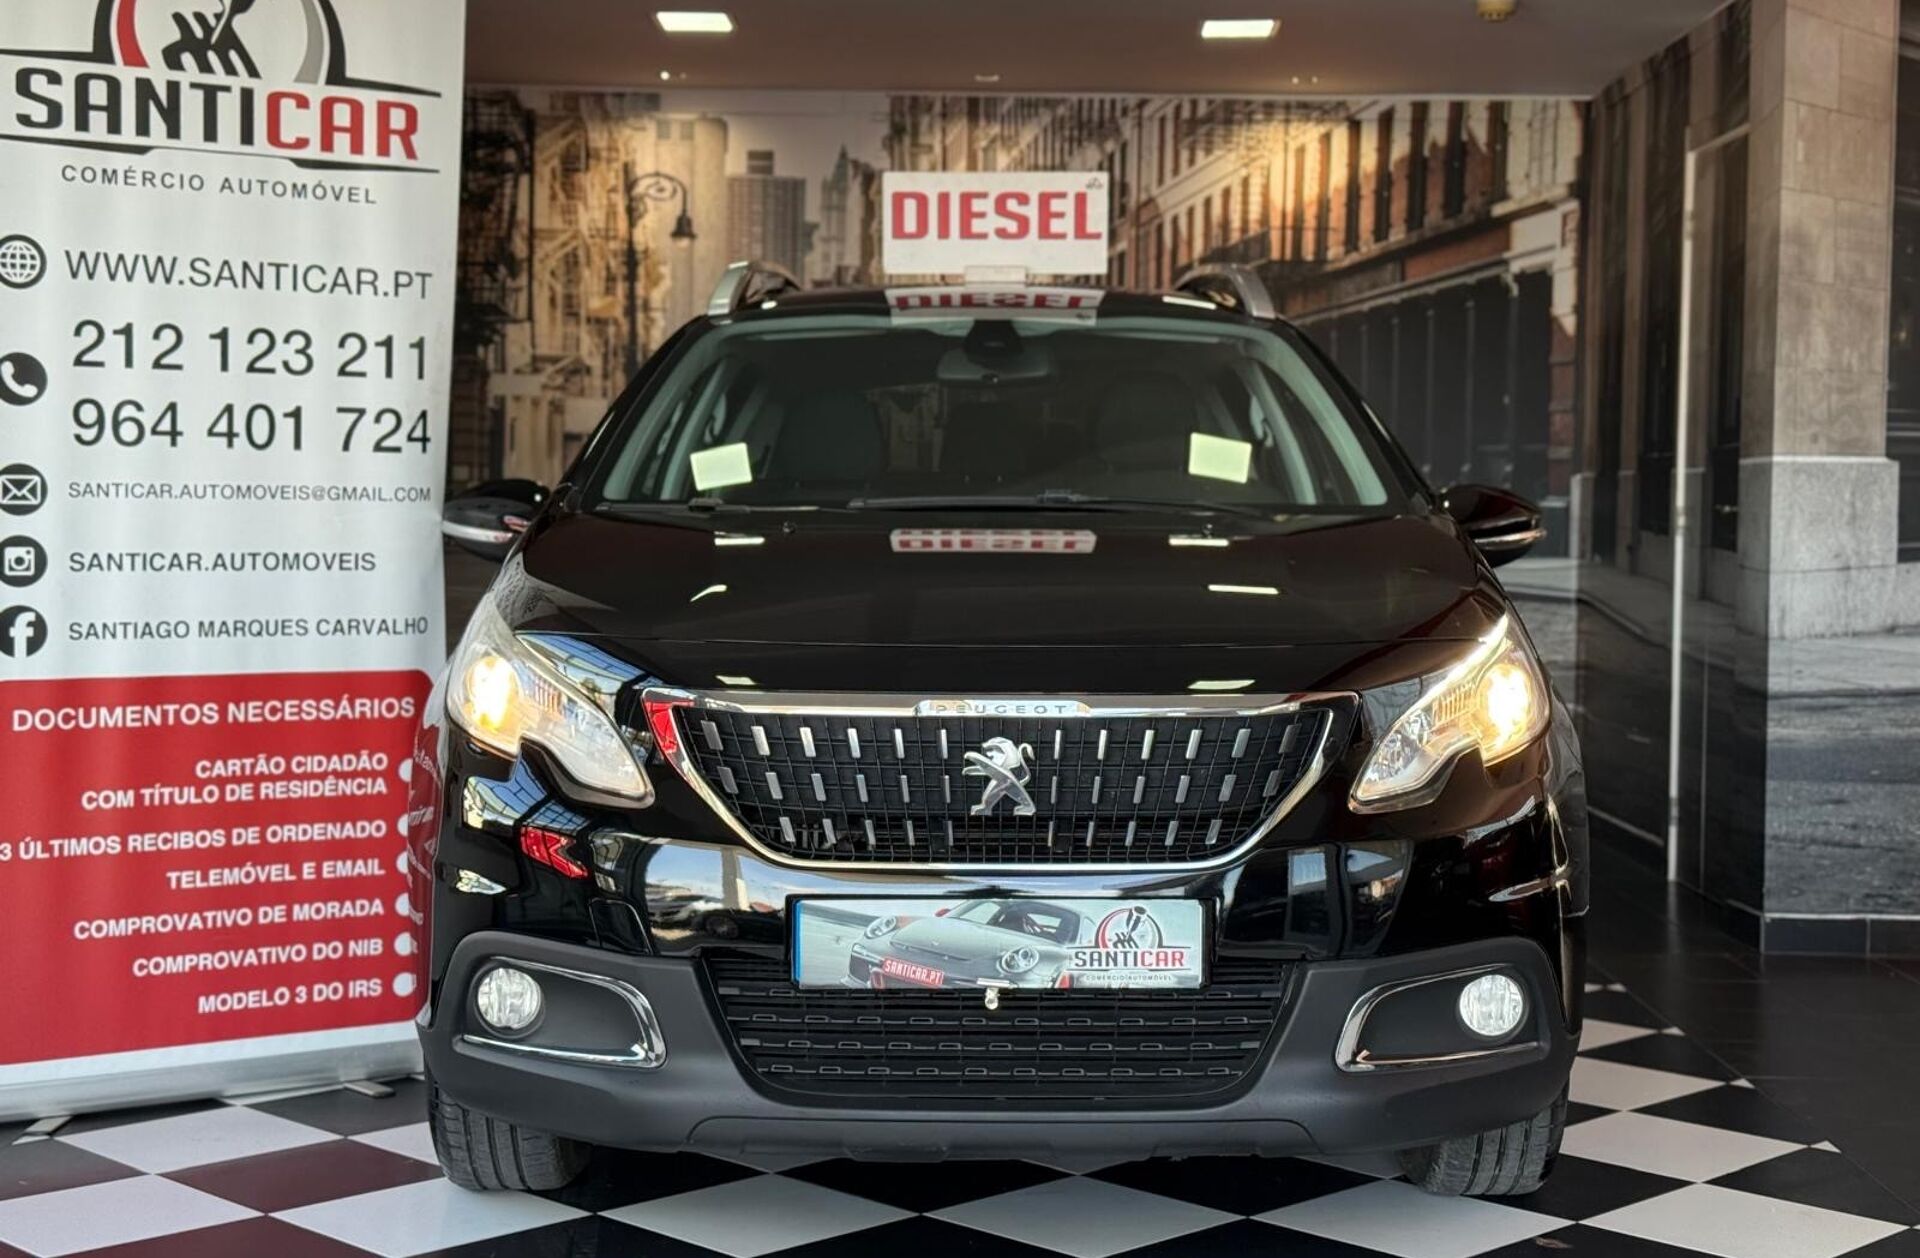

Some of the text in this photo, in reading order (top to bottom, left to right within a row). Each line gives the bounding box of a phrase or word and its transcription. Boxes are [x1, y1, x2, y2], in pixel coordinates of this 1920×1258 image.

[15, 66, 419, 161] SANTICAR
[61, 165, 377, 205] COMÉRCIO AUTOMÓVEL
[891, 191, 1103, 240] DIESEL
[64, 249, 433, 300] WWW.SANTICAR.PT
[72, 319, 426, 380] 212 123 211
[72, 398, 431, 454] 964 401 724
[68, 481, 432, 502] SANTICAR.AUTOMOVEIS@GMAIL.COM
[69, 551, 376, 572] SANTICAR.AUTOMOVEIS
[69, 616, 429, 641] SANTIAGO MARQUES CARVALHO
[12, 693, 415, 732] DOCUMENTOS NECESSÁRIOS
[935, 705, 1068, 715] PEUGEOT
[195, 753, 286, 779] CARTÃO
[291, 752, 388, 774] CIDADÃO
[81, 774, 387, 811] COM TÍTULO DE RESIDÊNCIA
[0, 819, 387, 862] 3 ÚLTIMOS RECIBOS DE ORDENADO
[166, 857, 386, 890] TELEMÓVEL E EMAIL
[73, 898, 385, 941] COMPROVATIVO DE MORADA
[132, 937, 384, 978] COMPROVATIVO DO NIB
[885, 960, 943, 985] SANTICAR.PT
[1074, 950, 1184, 967] SANTICAR
[198, 978, 383, 1015] MODELO 3 DO IRS
